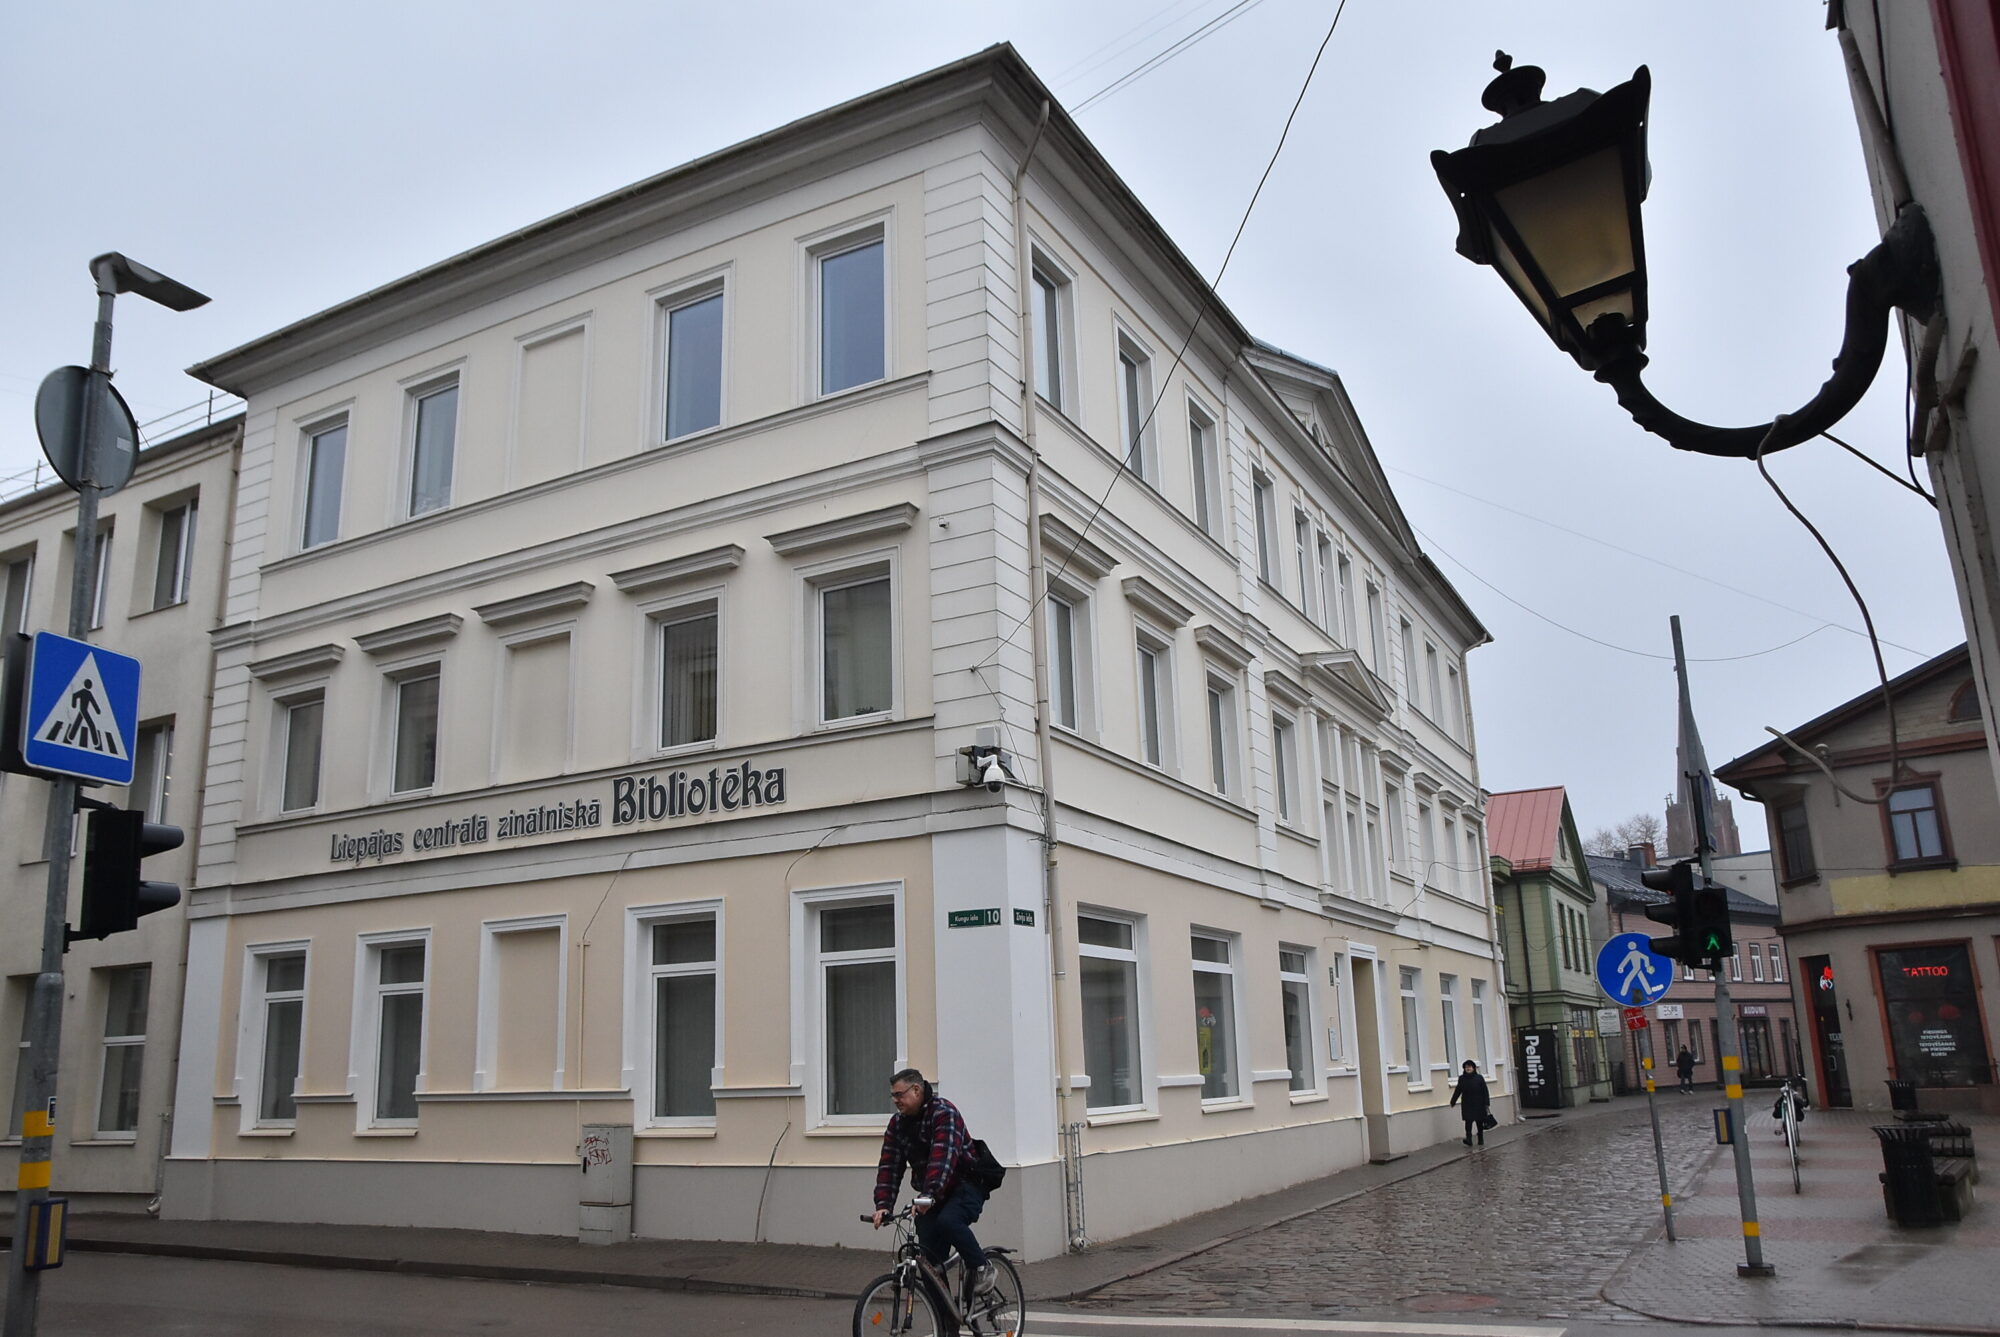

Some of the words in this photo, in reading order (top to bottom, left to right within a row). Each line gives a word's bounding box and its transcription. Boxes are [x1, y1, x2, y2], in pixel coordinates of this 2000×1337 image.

[330, 830, 403, 863] Liepājas
[412, 814, 487, 850] centrālā
[496, 799, 601, 839] zinātniskā
[612, 759, 787, 826] Bibliotēka
[986, 910, 1000, 923] 10
[1902, 966, 1948, 976] TATTOO
[1524, 1035, 1546, 1086] Pellini
